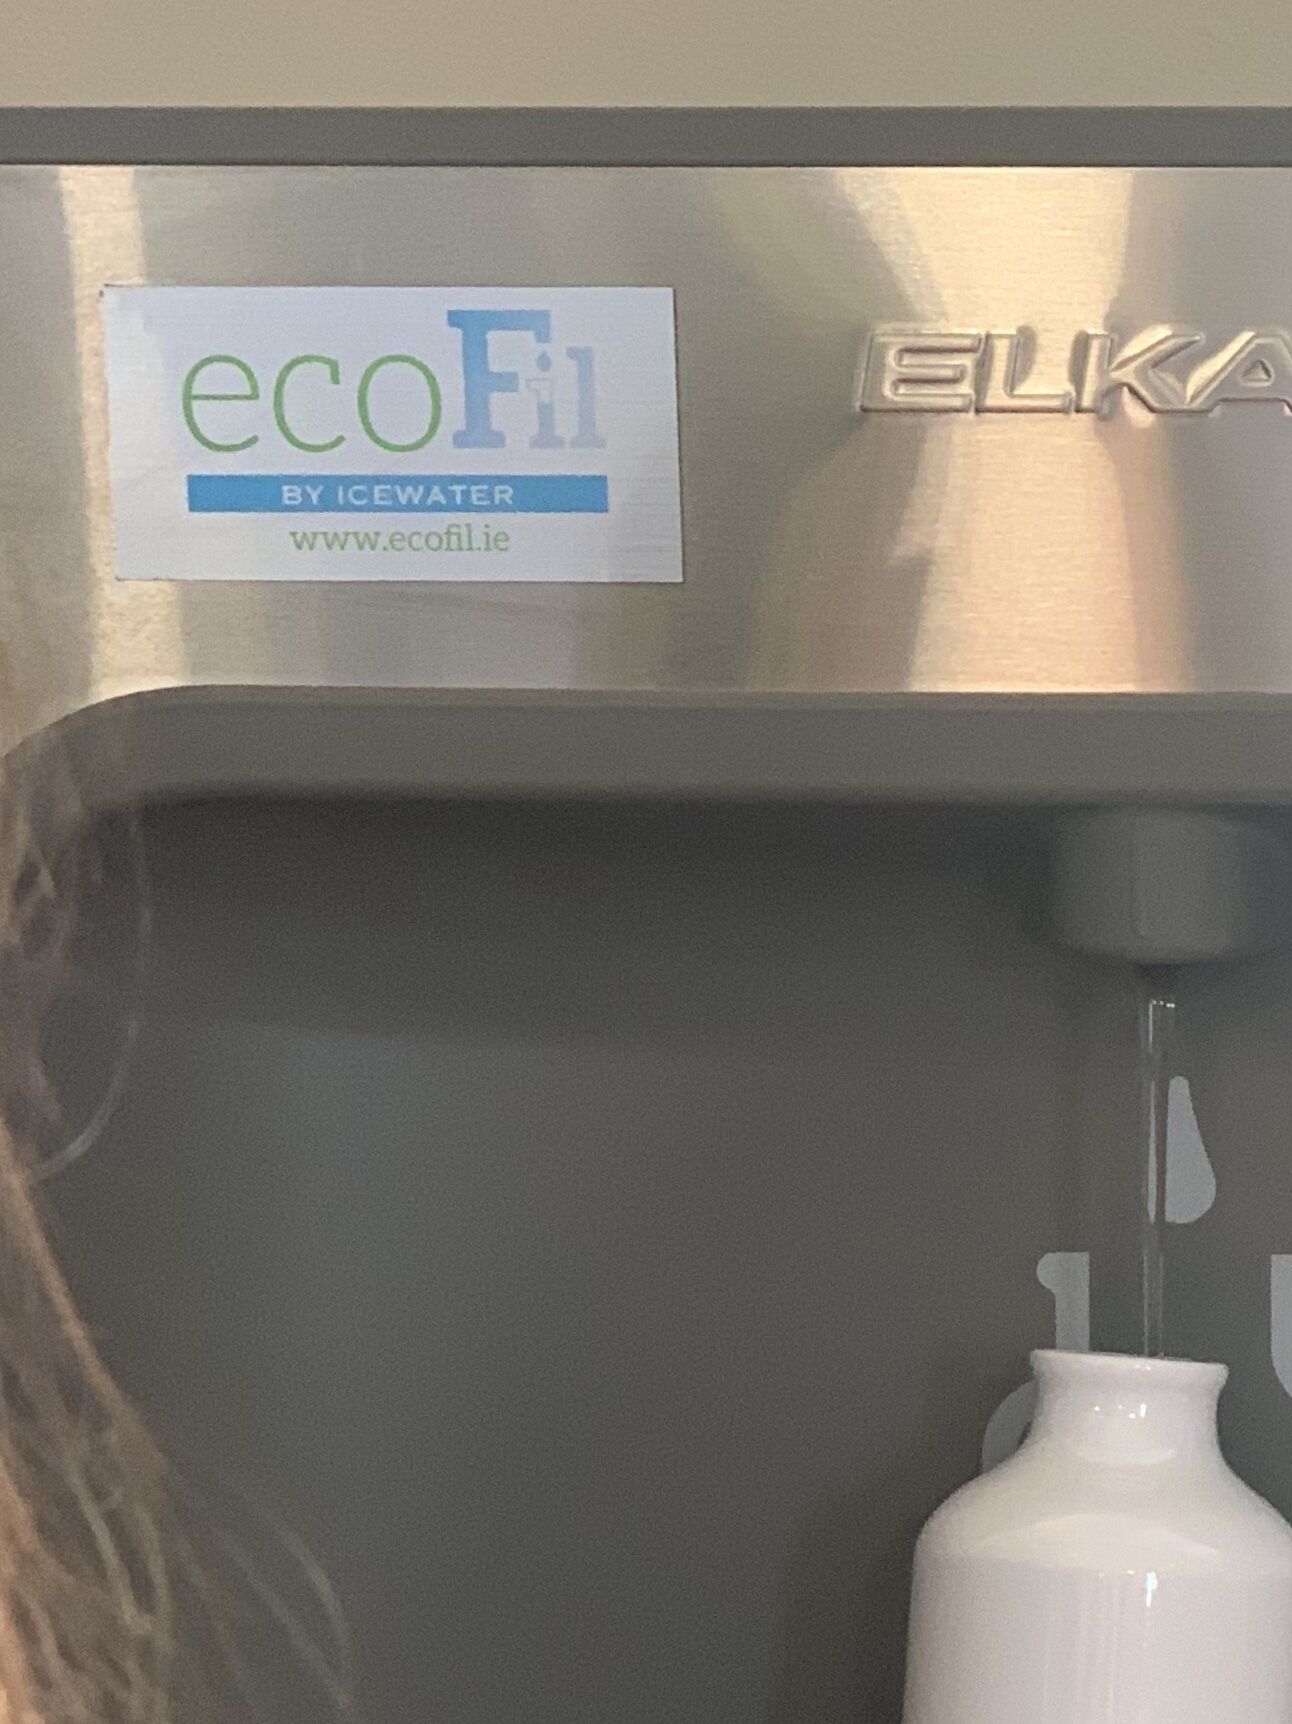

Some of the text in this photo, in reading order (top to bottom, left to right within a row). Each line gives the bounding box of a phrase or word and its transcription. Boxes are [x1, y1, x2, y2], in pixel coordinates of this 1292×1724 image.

[181, 309, 608, 453] ecoFil
[281, 484, 514, 506] BY ICEWATER
[289, 523, 510, 552] www.ecofil.ie
